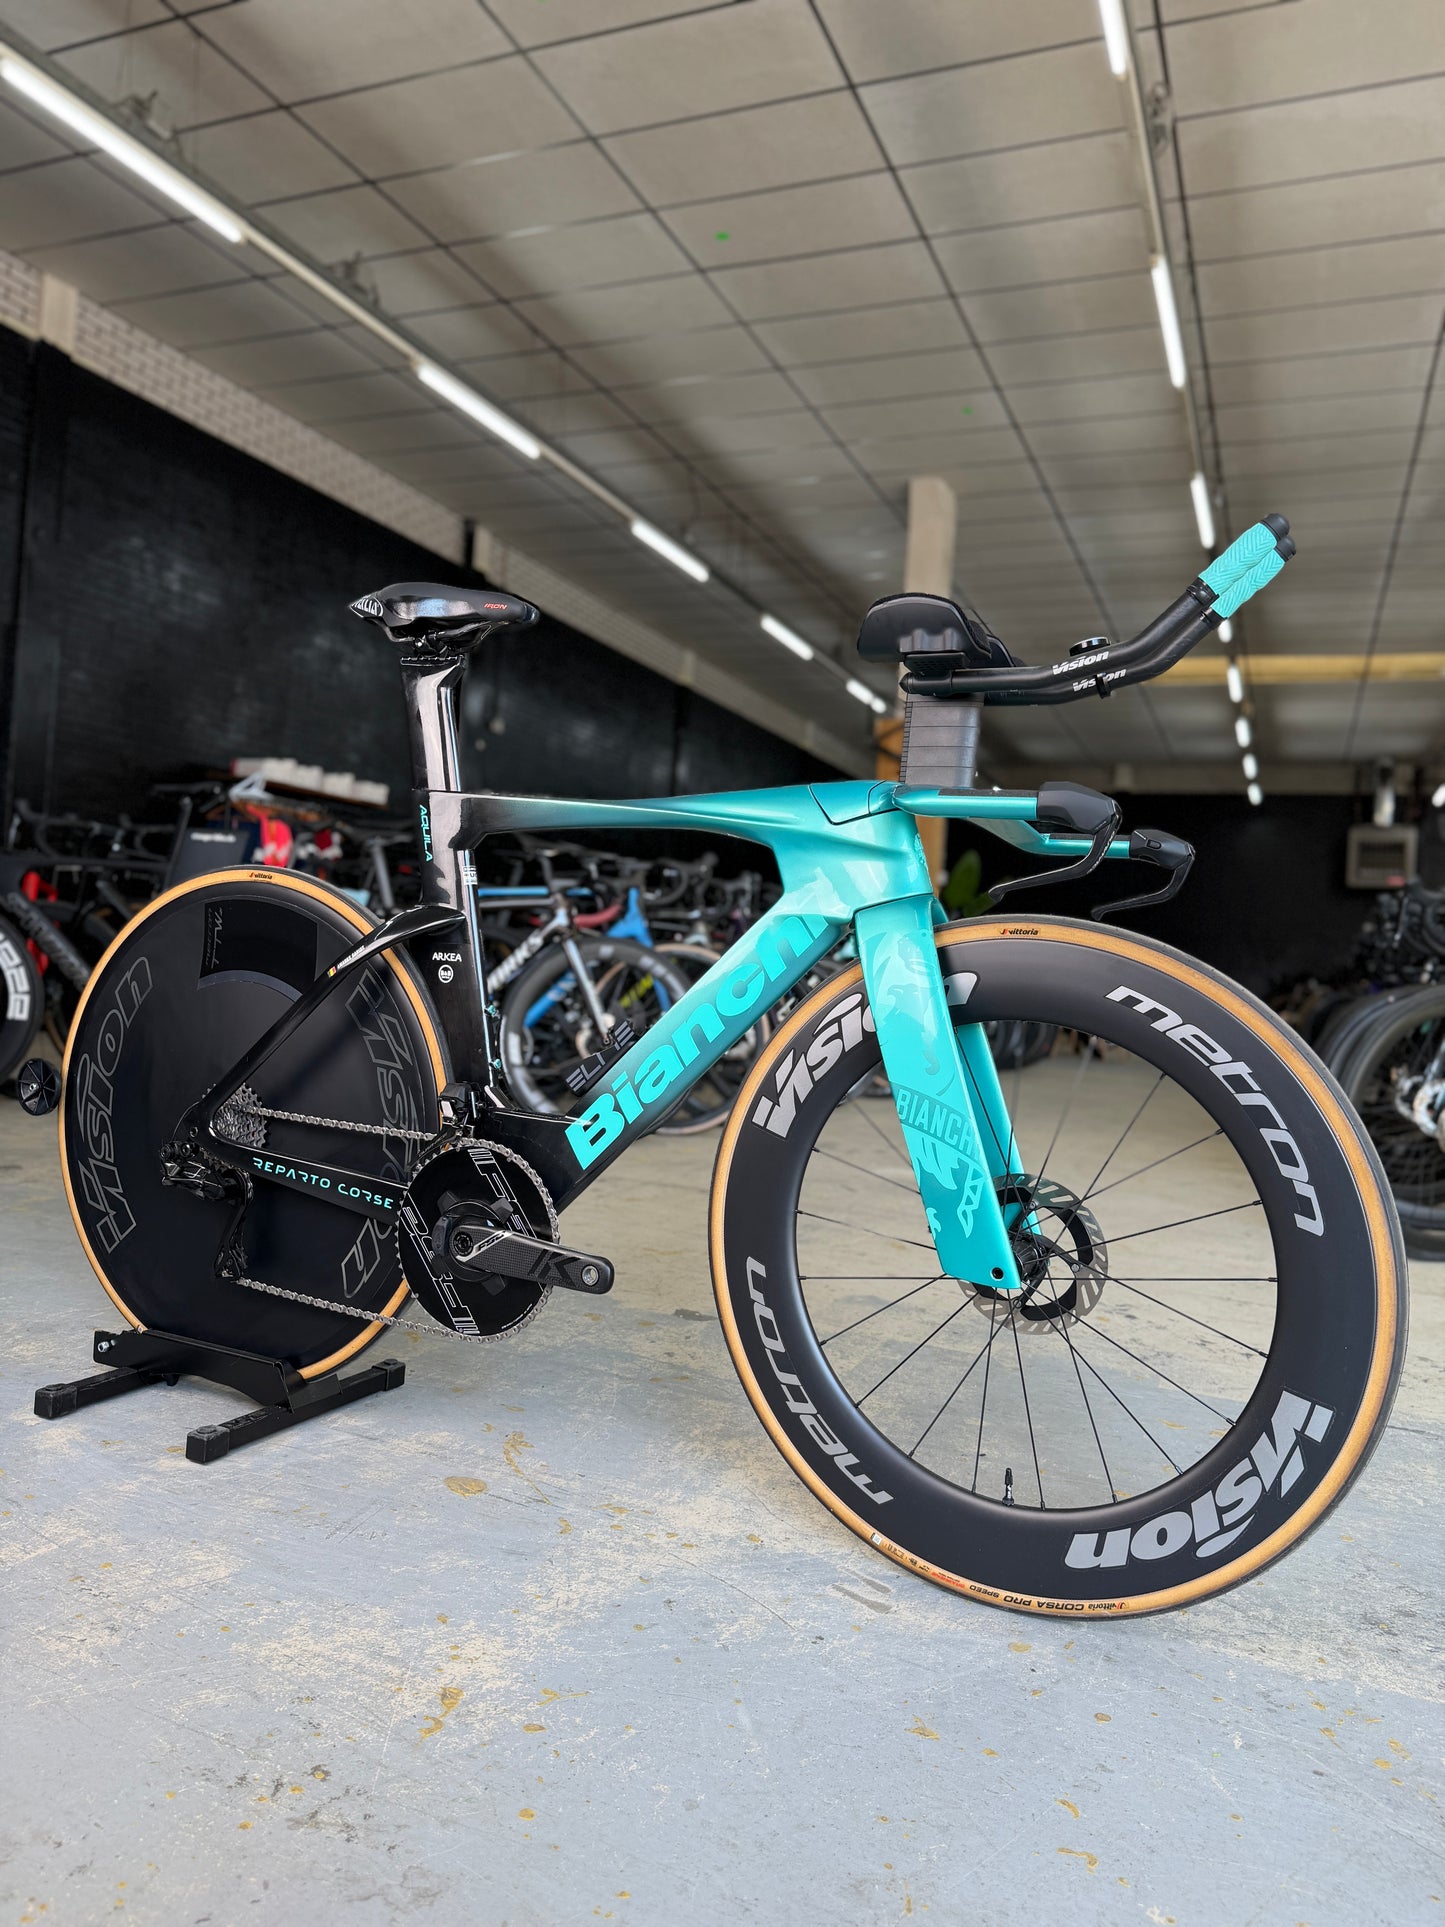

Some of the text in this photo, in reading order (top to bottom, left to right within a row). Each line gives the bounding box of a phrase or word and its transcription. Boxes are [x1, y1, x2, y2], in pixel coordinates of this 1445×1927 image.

[1052, 651, 1109, 675] Vision
[1072, 668, 1127, 692] Vison
[419, 804, 433, 862] AQUILA
[1007, 928, 1039, 936] vittoria
[432, 952, 463, 962] ARKEA
[76, 956, 153, 1254] Vision
[1105, 985, 1325, 1237] metron
[252, 1157, 394, 1209] REPARTO CORSE
[746, 1256, 895, 1505] metron
[1064, 1390, 1334, 1569] Vision
[969, 1584, 999, 1598] SPEED
[1003, 1594, 1031, 1607] PRO
[1037, 1601, 1085, 1611] CORSA
[1088, 1602, 1118, 1611] vittoria
